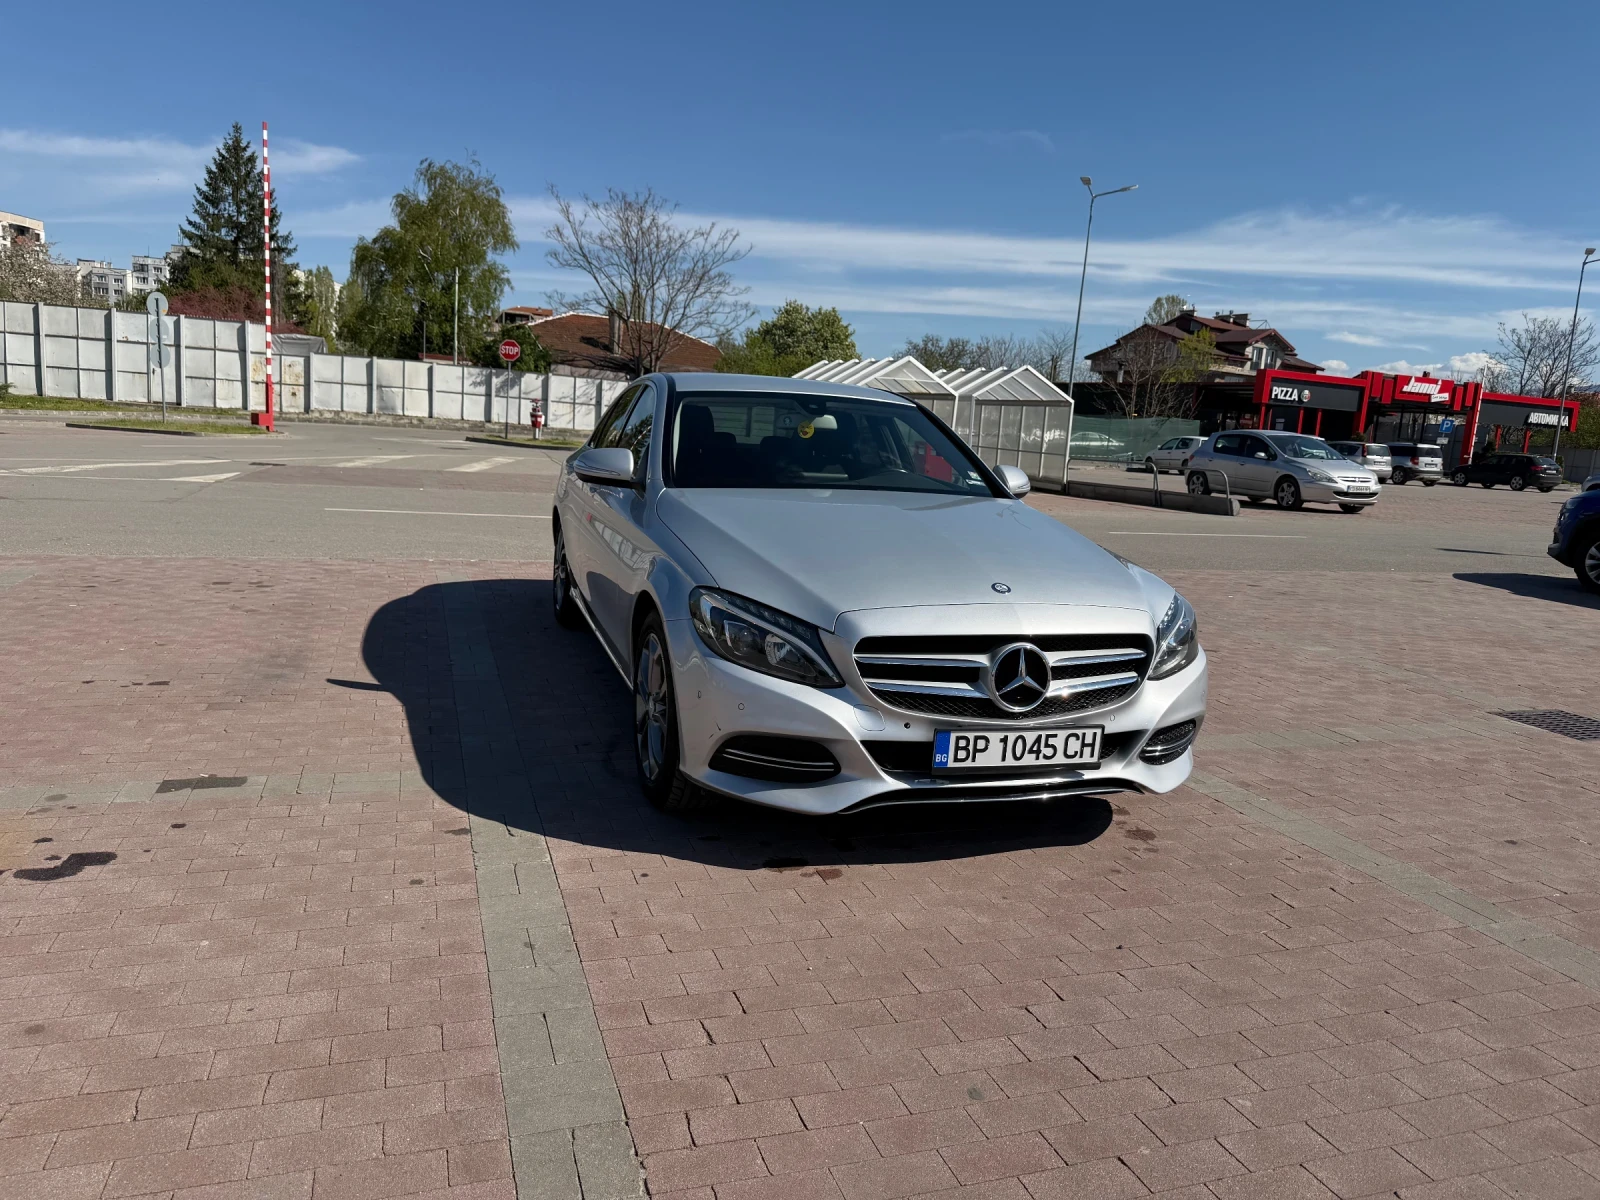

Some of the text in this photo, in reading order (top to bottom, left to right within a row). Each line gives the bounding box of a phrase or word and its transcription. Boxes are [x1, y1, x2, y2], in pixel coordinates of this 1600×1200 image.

[501, 345, 519, 355] STOP
[1271, 386, 1299, 401] PIZZA
[1443, 420, 1451, 431] P
[953, 732, 1098, 763] BP 1045 CH
[935, 753, 948, 763] BG
